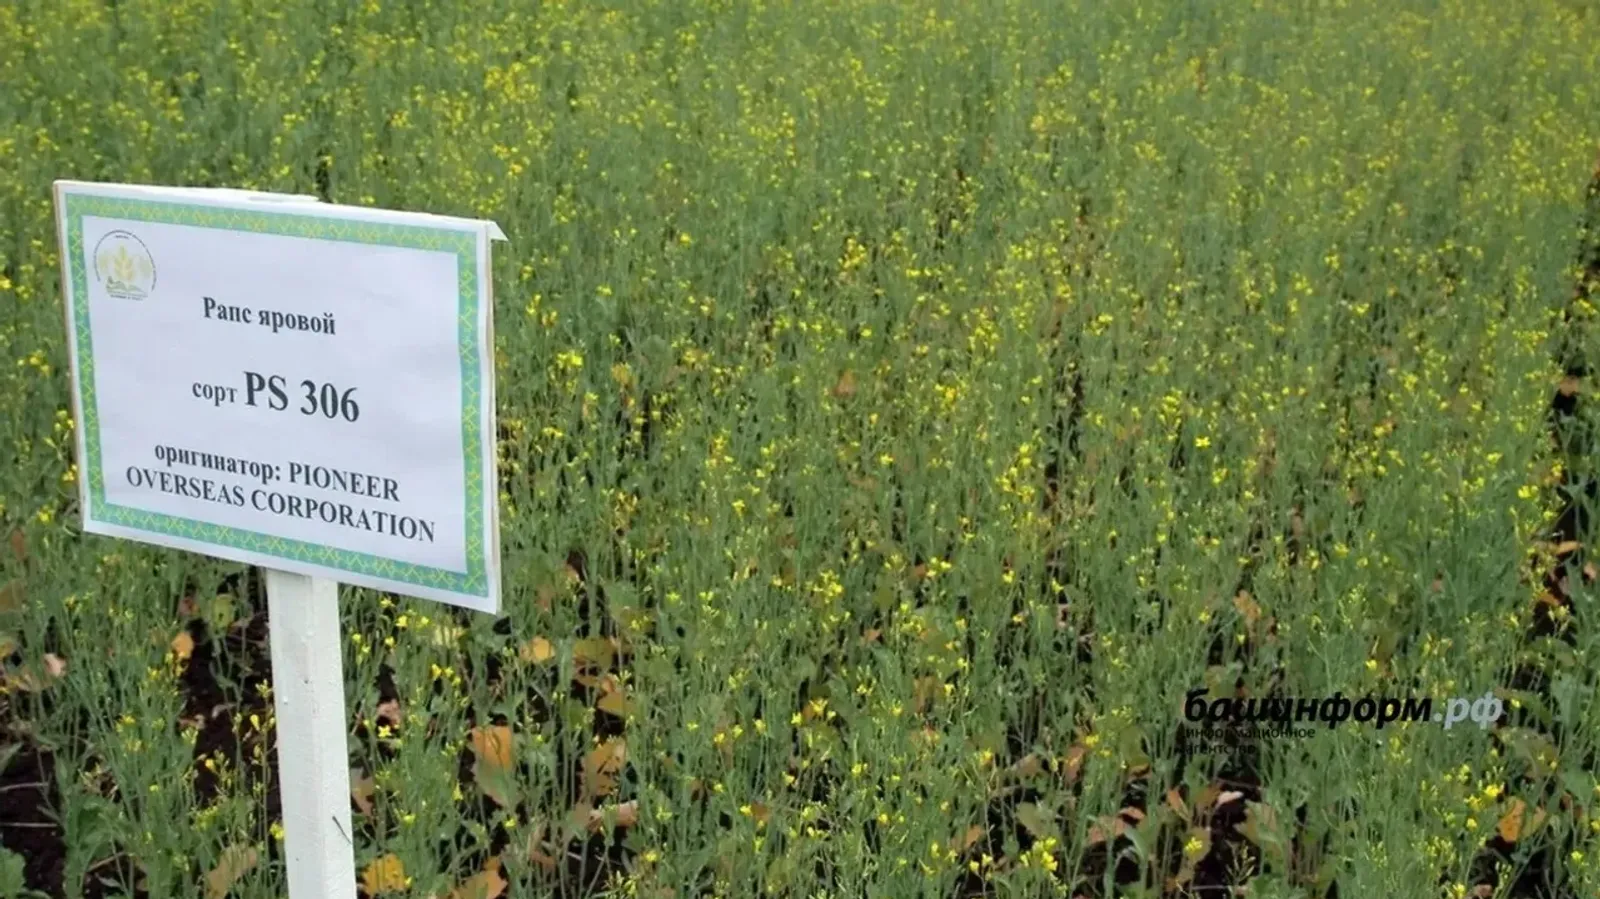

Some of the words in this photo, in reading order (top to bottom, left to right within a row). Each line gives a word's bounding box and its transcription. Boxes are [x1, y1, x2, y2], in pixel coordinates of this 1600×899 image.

[203, 296, 253, 324] Рапс
[258, 310, 335, 335] яровой
[192, 382, 235, 407] сорт
[244, 371, 289, 411] PS
[300, 379, 360, 423] 306
[154, 445, 281, 484] оригинатор:
[288, 462, 400, 503] PIONEER
[126, 466, 246, 510] OVERSEAS
[251, 489, 435, 543] CORPORATION
